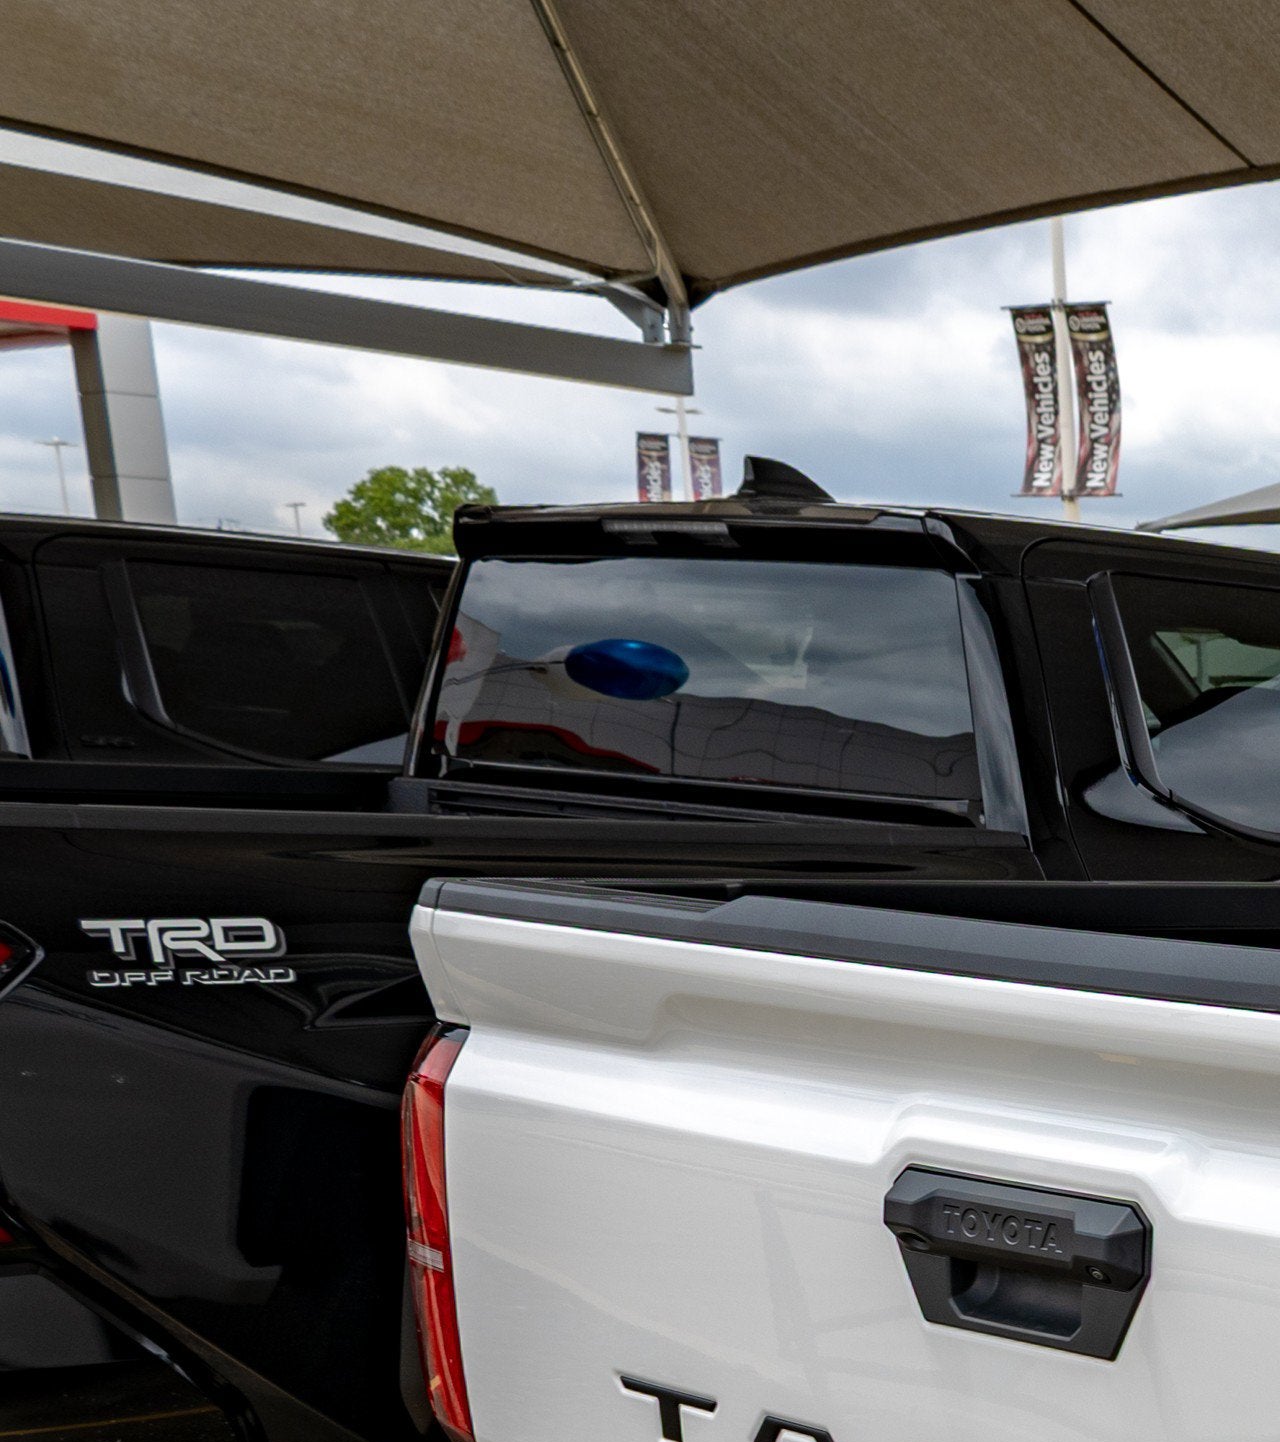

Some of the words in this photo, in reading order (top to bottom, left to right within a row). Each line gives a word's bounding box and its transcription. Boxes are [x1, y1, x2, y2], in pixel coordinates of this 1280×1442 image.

[1033, 352, 1055, 439] Vehicles
[1086, 350, 1110, 438] Vehicles
[1033, 445, 1054, 487] New
[1086, 443, 1109, 487] New
[80, 917, 287, 970] TRD
[88, 968, 173, 987] OFF
[182, 967, 297, 986] ROAD
[942, 1204, 1063, 1254] TOYOTA
